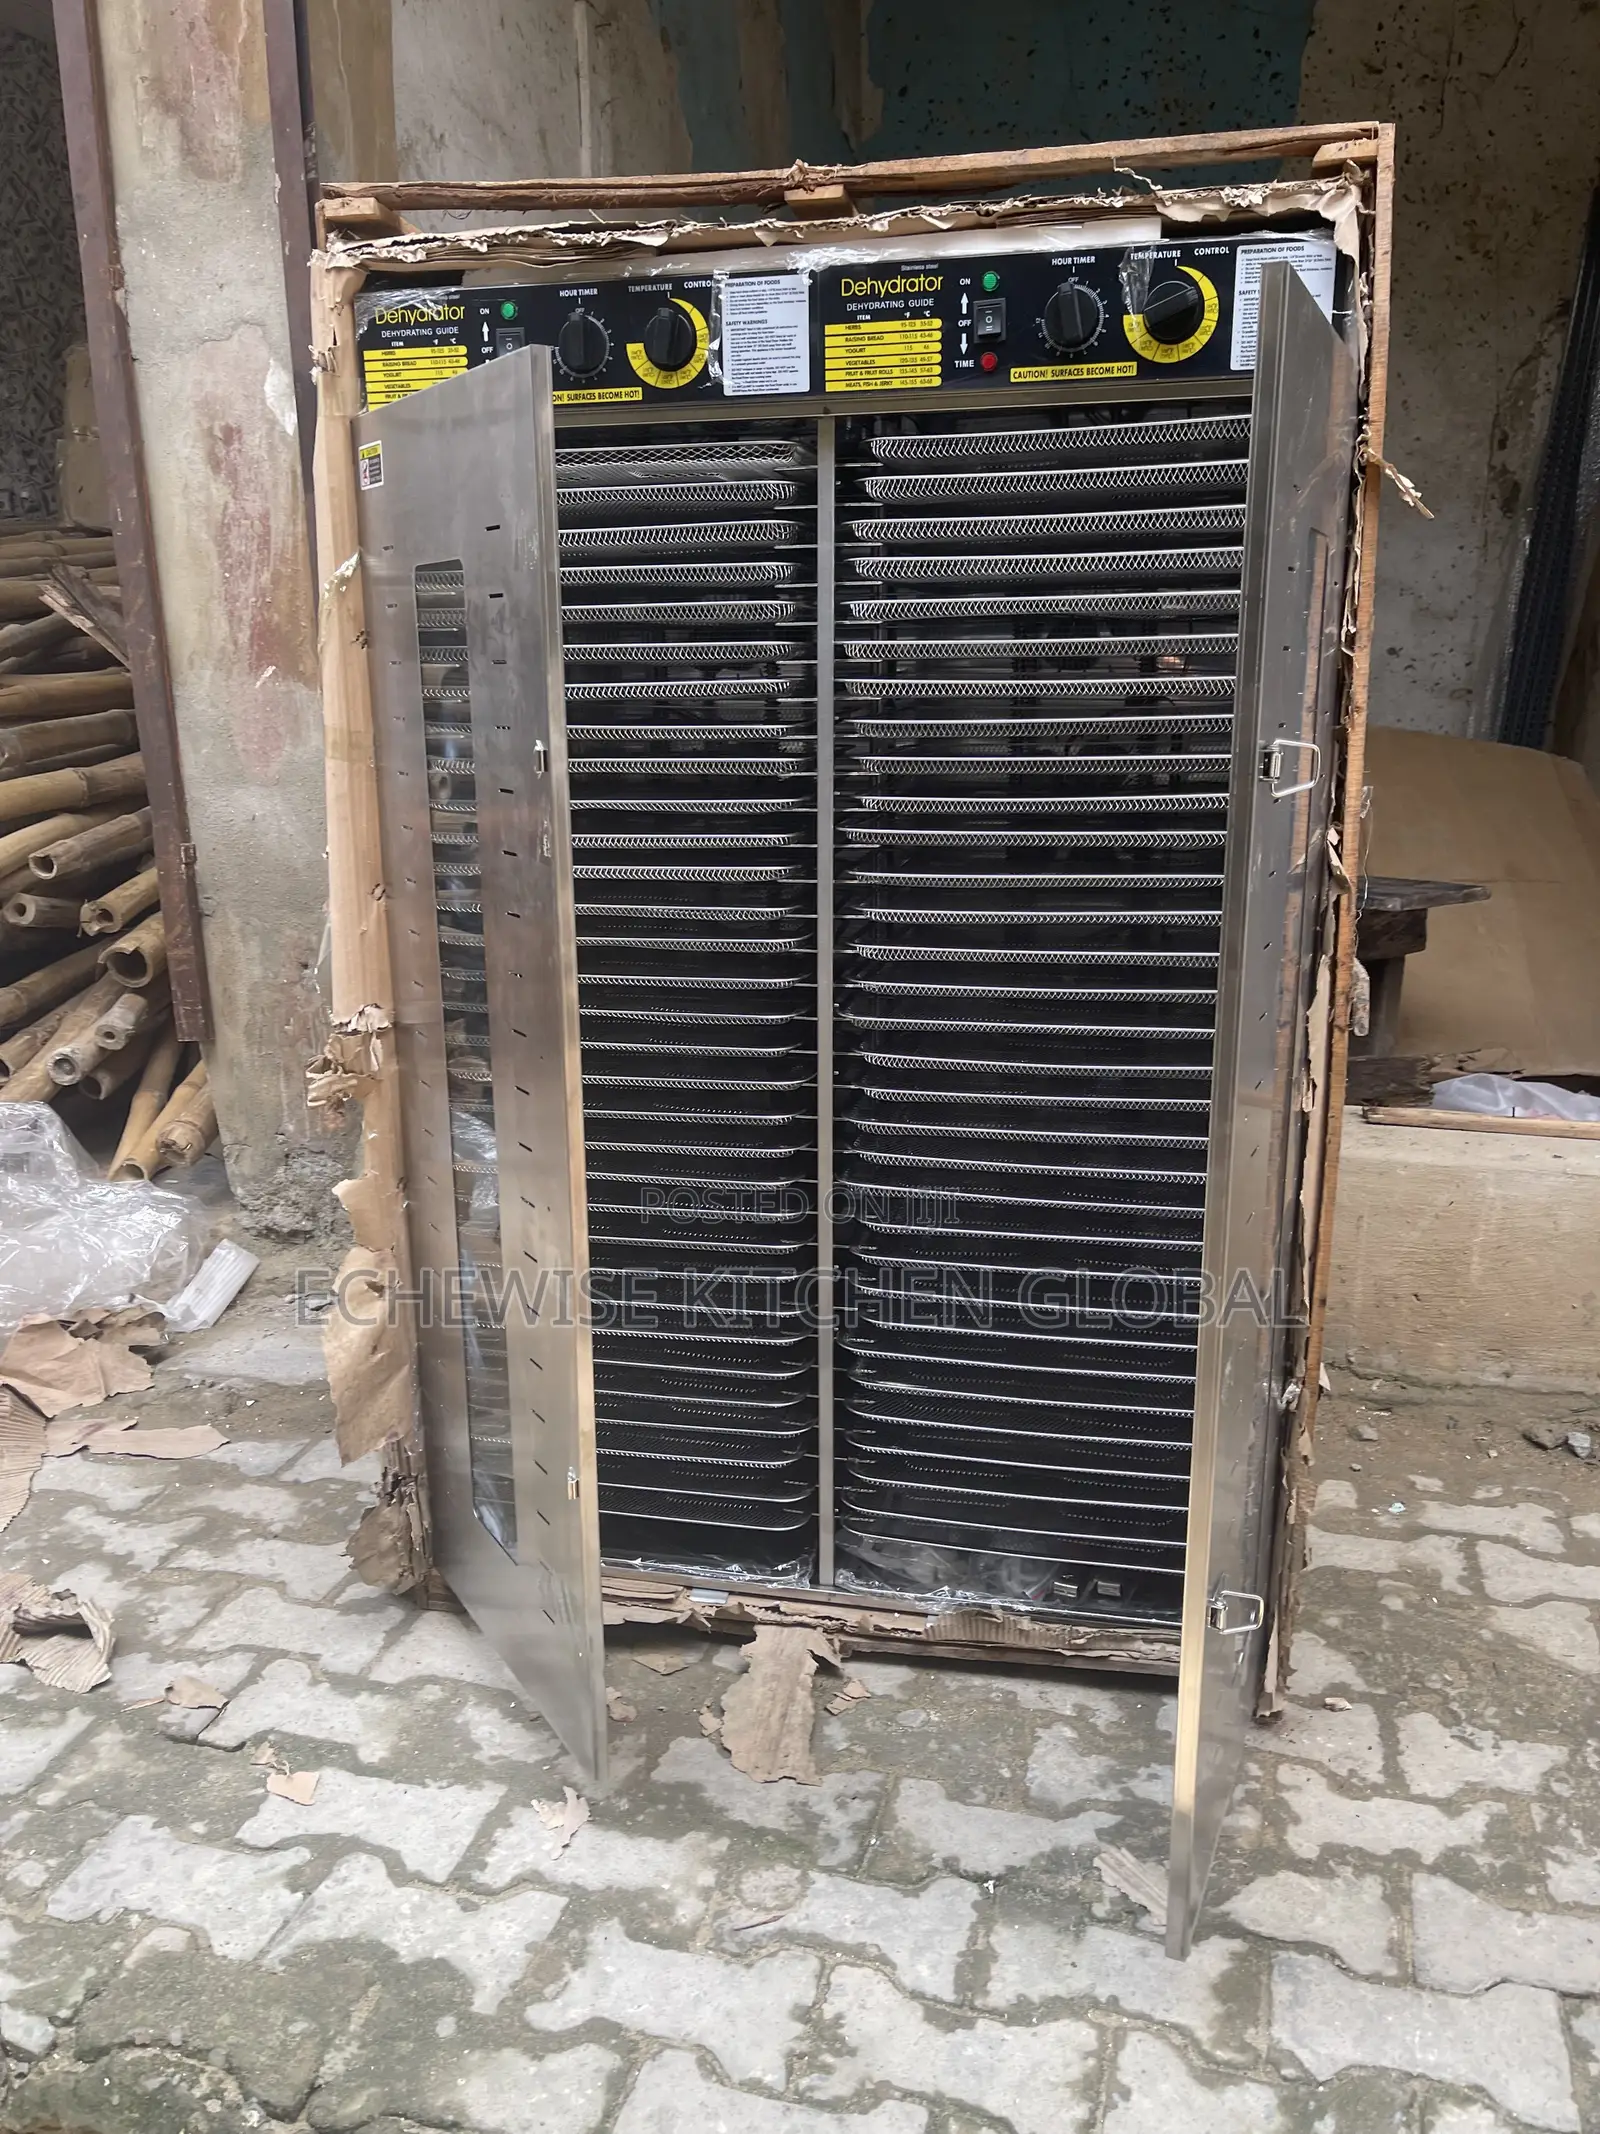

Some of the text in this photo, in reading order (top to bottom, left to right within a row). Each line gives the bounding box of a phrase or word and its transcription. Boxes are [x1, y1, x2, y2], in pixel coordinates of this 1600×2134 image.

[1130, 246, 1230, 261] TEMPERATURE CONTROL
[1241, 247, 1277, 255] PREPARATION
[1051, 255, 1096, 266] HOUR TIMER
[841, 273, 944, 298] Dehydrator
[959, 278, 971, 286] ON
[559, 287, 598, 297] HOUR TIMER
[628, 283, 673, 293] TEMPERATURE
[846, 297, 935, 312] DEHYDRATING GUIDE
[374, 303, 467, 326] Dehydrator
[479, 307, 491, 315] ON
[957, 320, 972, 328] OFF
[381, 326, 460, 339] DEHYDRATING GUIDE
[481, 346, 494, 354] OFF
[845, 359, 876, 367] VEGETABLES
[954, 359, 975, 369] TIME
[1013, 363, 1135, 380] CAUTION! SURFACES BECOME HOT!
[567, 391, 597, 402] SURFACES
[597, 389, 624, 400] BECOME
[624, 388, 641, 398] HOT!
